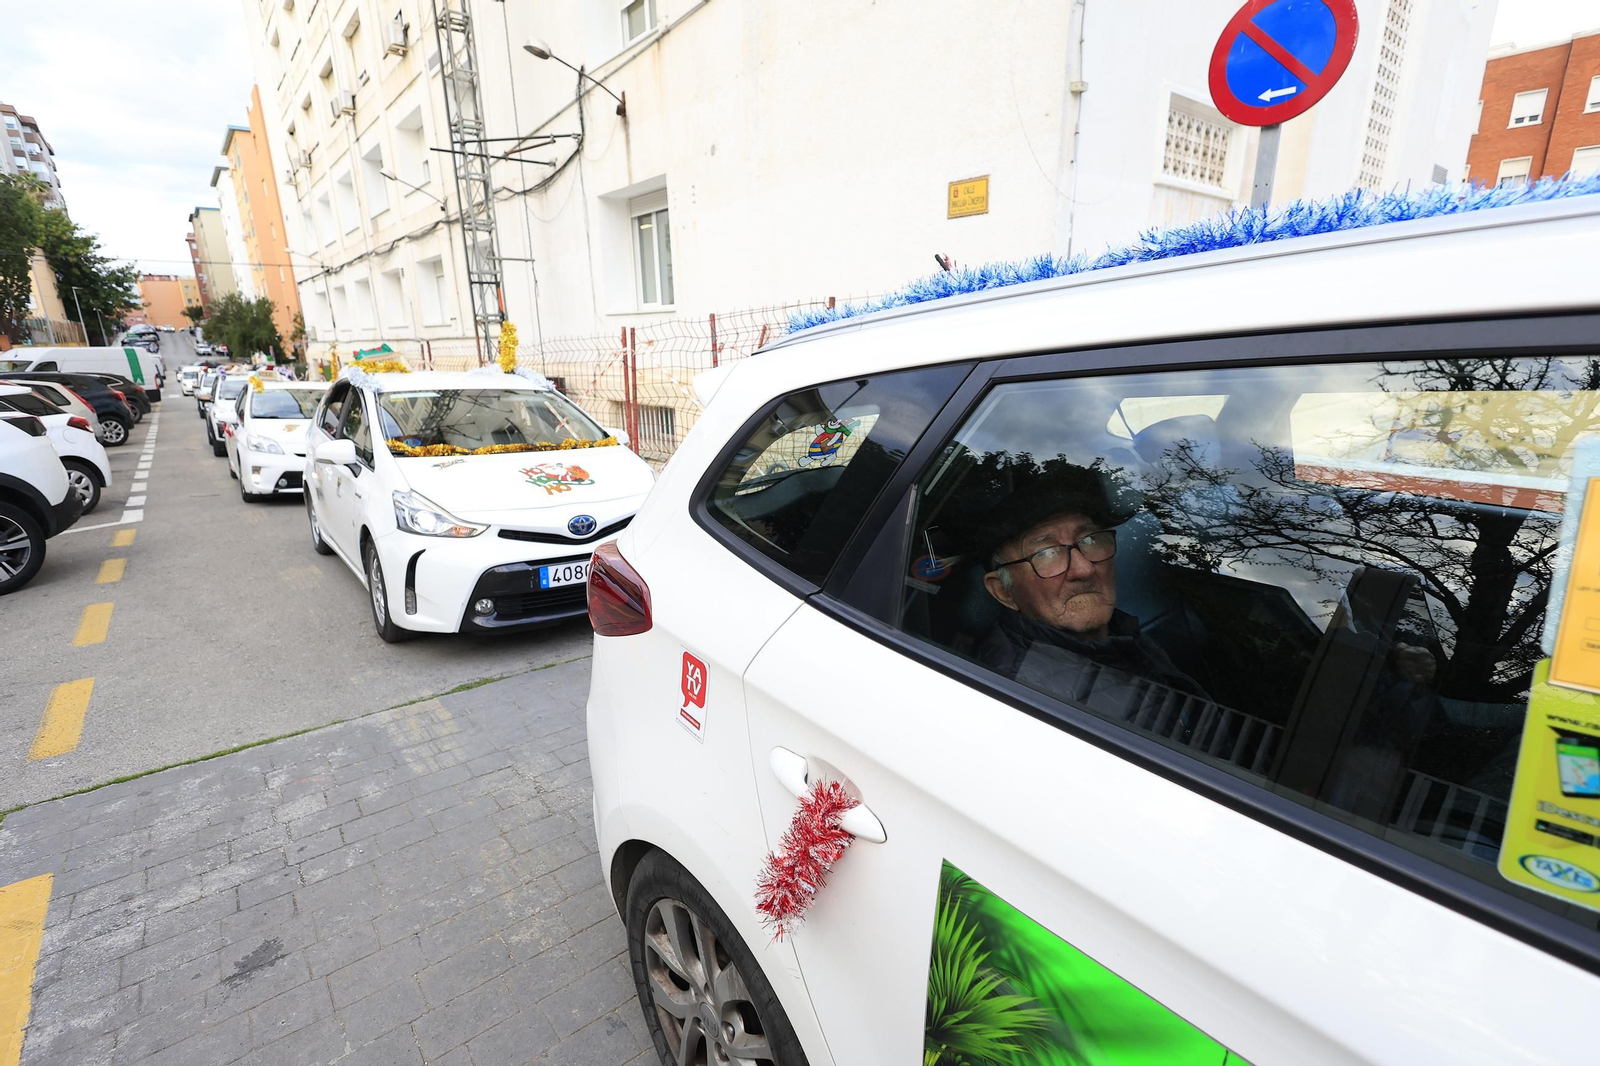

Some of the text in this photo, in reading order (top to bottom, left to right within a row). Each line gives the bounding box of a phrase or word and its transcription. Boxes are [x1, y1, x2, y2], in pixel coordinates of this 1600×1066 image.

[543, 483, 572, 495] HO
[686, 660, 702, 684] YA
[686, 674, 702, 696] TV
